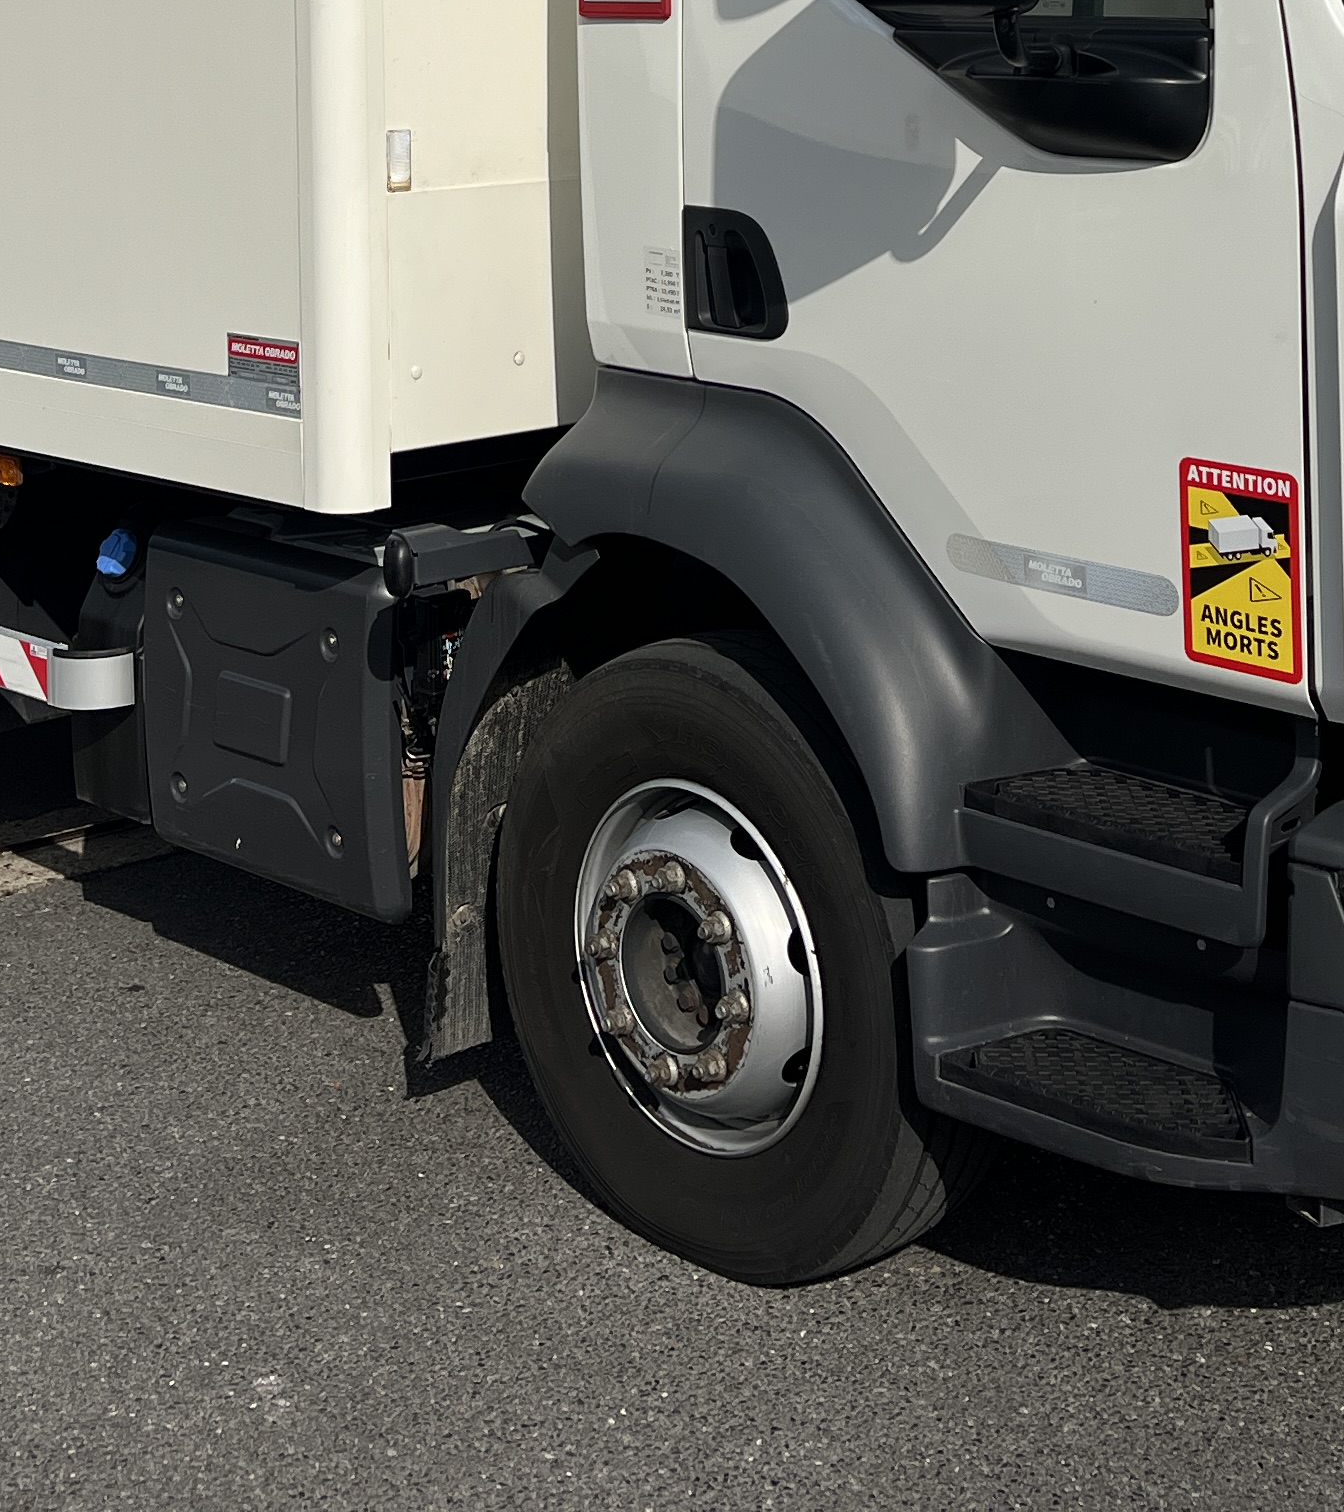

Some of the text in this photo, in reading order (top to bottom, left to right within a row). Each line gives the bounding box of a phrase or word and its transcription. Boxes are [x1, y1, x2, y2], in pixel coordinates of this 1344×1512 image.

[231, 341, 264, 357] MOLETTA
[1187, 464, 1291, 498] ATTENTION
[1028, 559, 1072, 578] MOLETTA
[1041, 572, 1083, 588] OBRADO
[1200, 603, 1283, 638] ANGLES
[1206, 626, 1280, 661] MORTS
